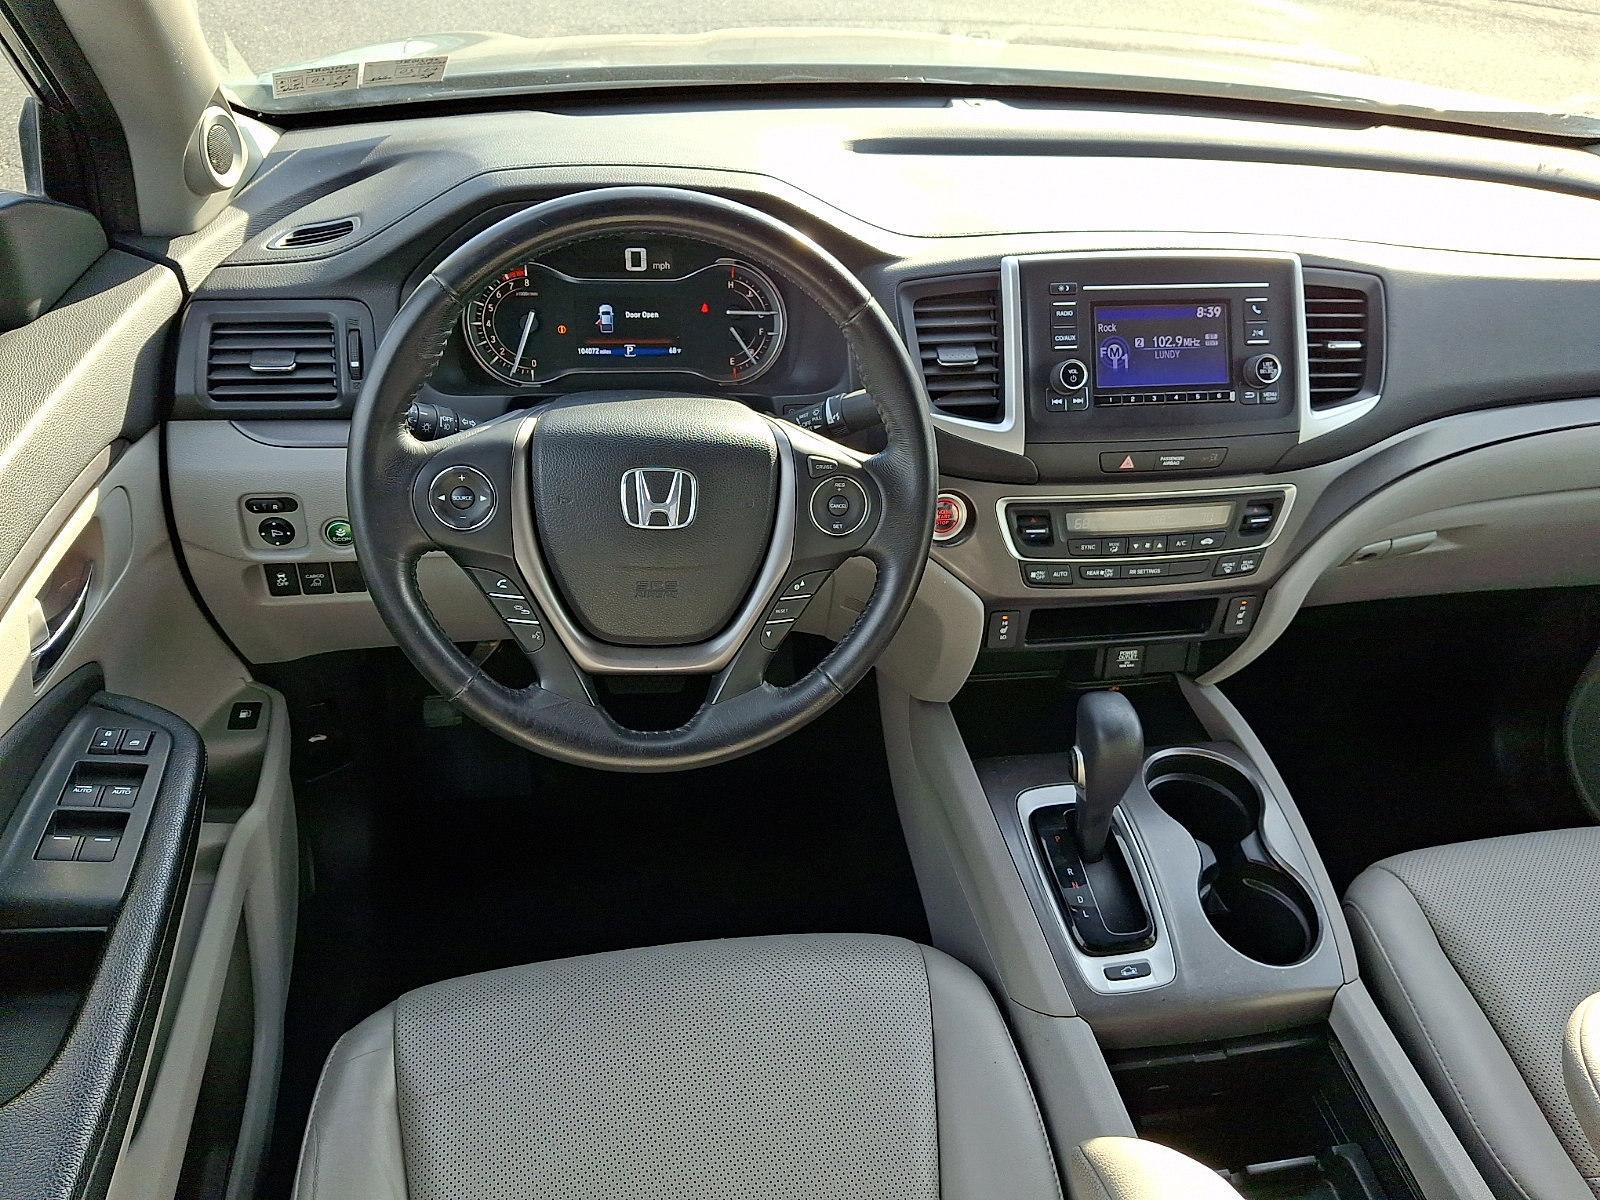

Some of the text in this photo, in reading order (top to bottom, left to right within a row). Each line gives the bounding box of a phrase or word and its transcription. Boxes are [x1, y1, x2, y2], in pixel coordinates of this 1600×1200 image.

[625, 248, 671, 271] 0 mph
[509, 282, 514, 290] 7
[524, 278, 530, 287] 8
[728, 281, 734, 289] H
[496, 291, 502, 299] 6
[488, 304, 494, 312] 5
[1196, 306, 1222, 318] 8:39
[625, 311, 659, 320] Door Open
[758, 328, 764, 336] F
[1097, 323, 1117, 333] Rock
[490, 335, 497, 343] 3
[1135, 337, 1144, 347] 2
[1152, 335, 1183, 348] 102.9
[1183, 337, 1201, 347] MHz
[500, 348, 505, 356] 2
[1154, 350, 1181, 360] LUNDY
[729, 357, 736, 366] E
[442, 415, 454, 423] OFF
[1067, 868, 1074, 876] R
[1077, 895, 1084, 903] D
[1083, 910, 1089, 918] L
